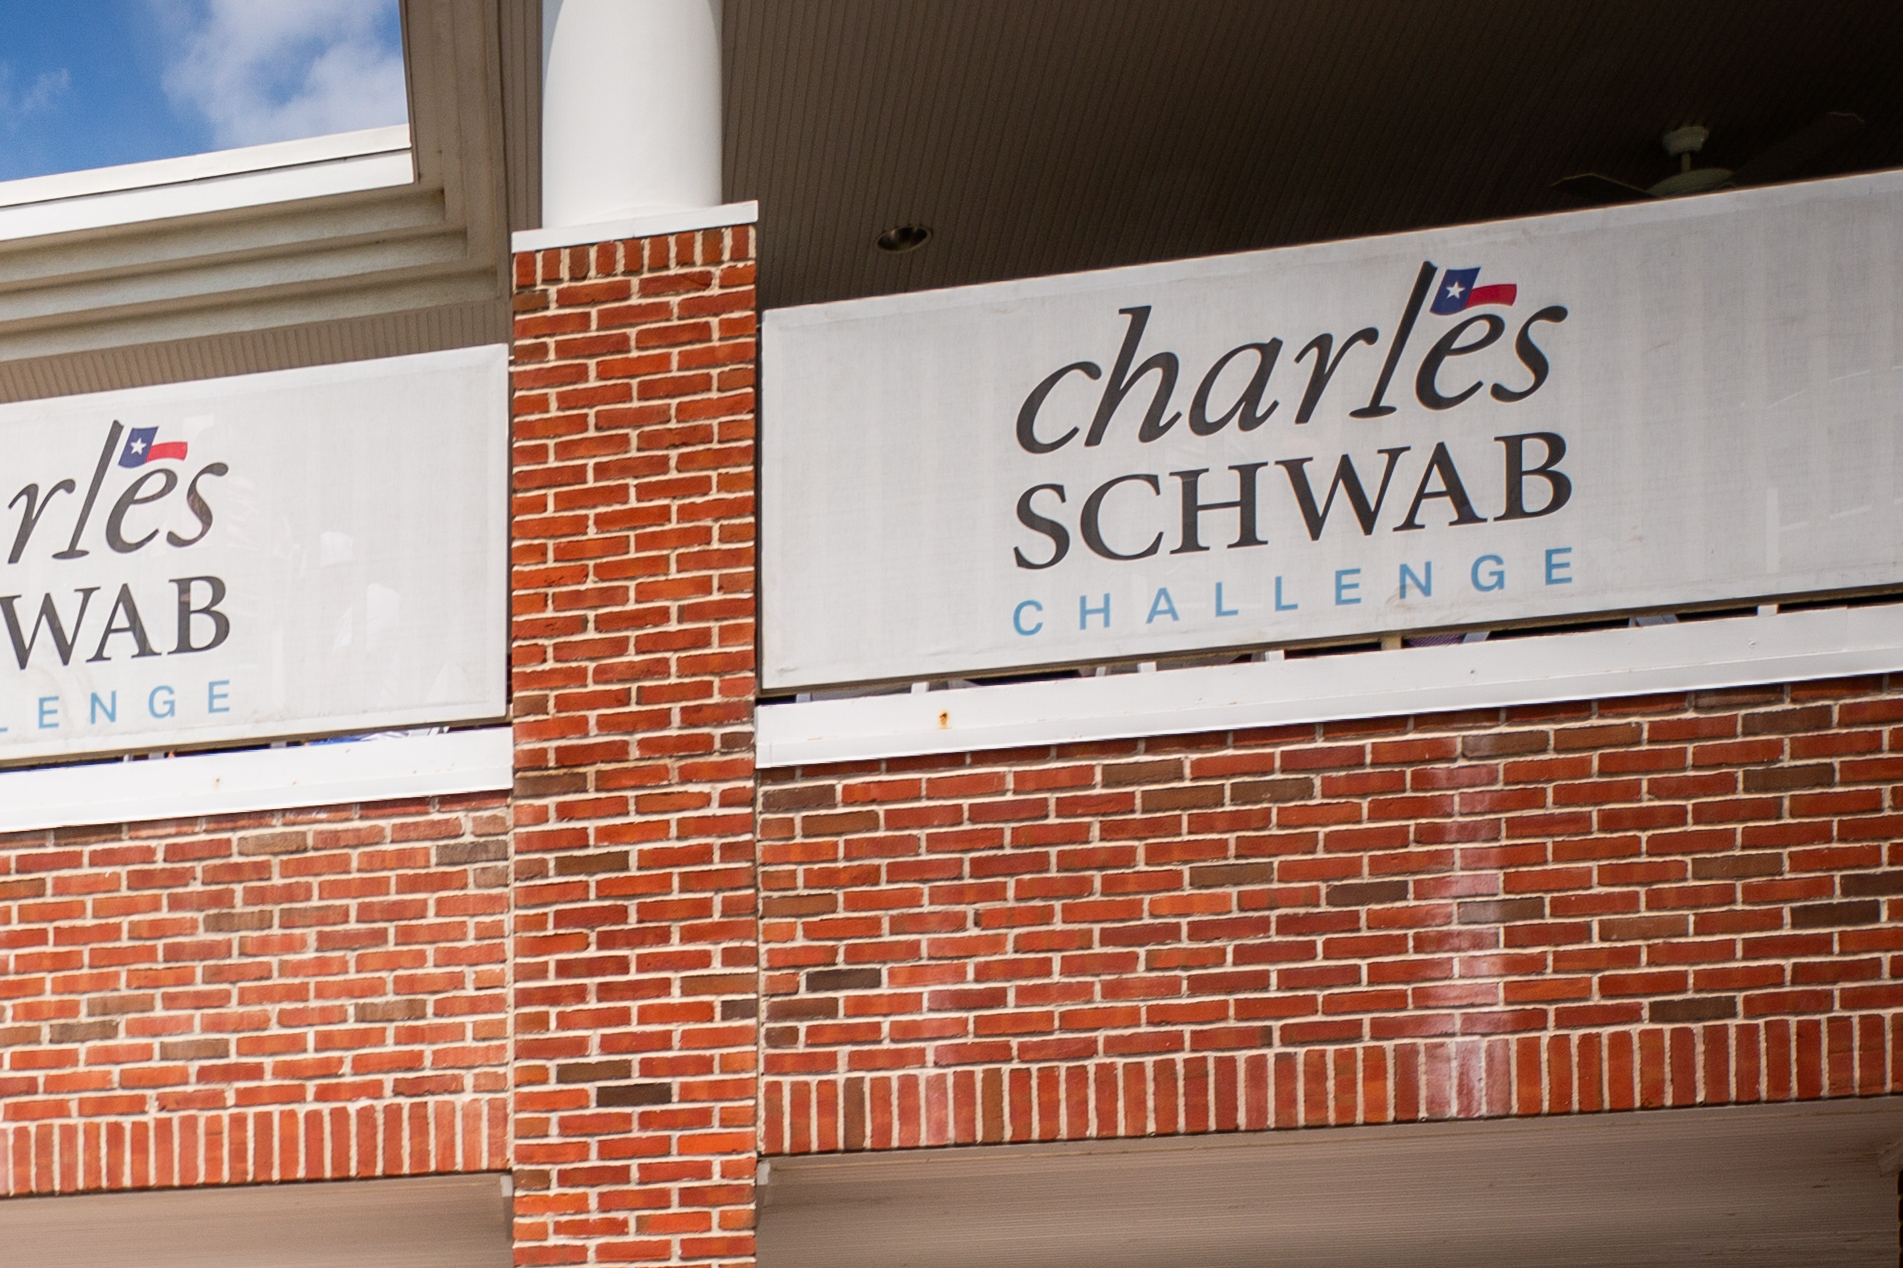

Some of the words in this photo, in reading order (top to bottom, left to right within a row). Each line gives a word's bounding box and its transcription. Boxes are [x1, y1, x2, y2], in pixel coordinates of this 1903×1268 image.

[1014, 260, 1570, 454] charles
[1012, 431, 1574, 570] SCHWAB
[1011, 546, 1575, 637] CHALLENGE
